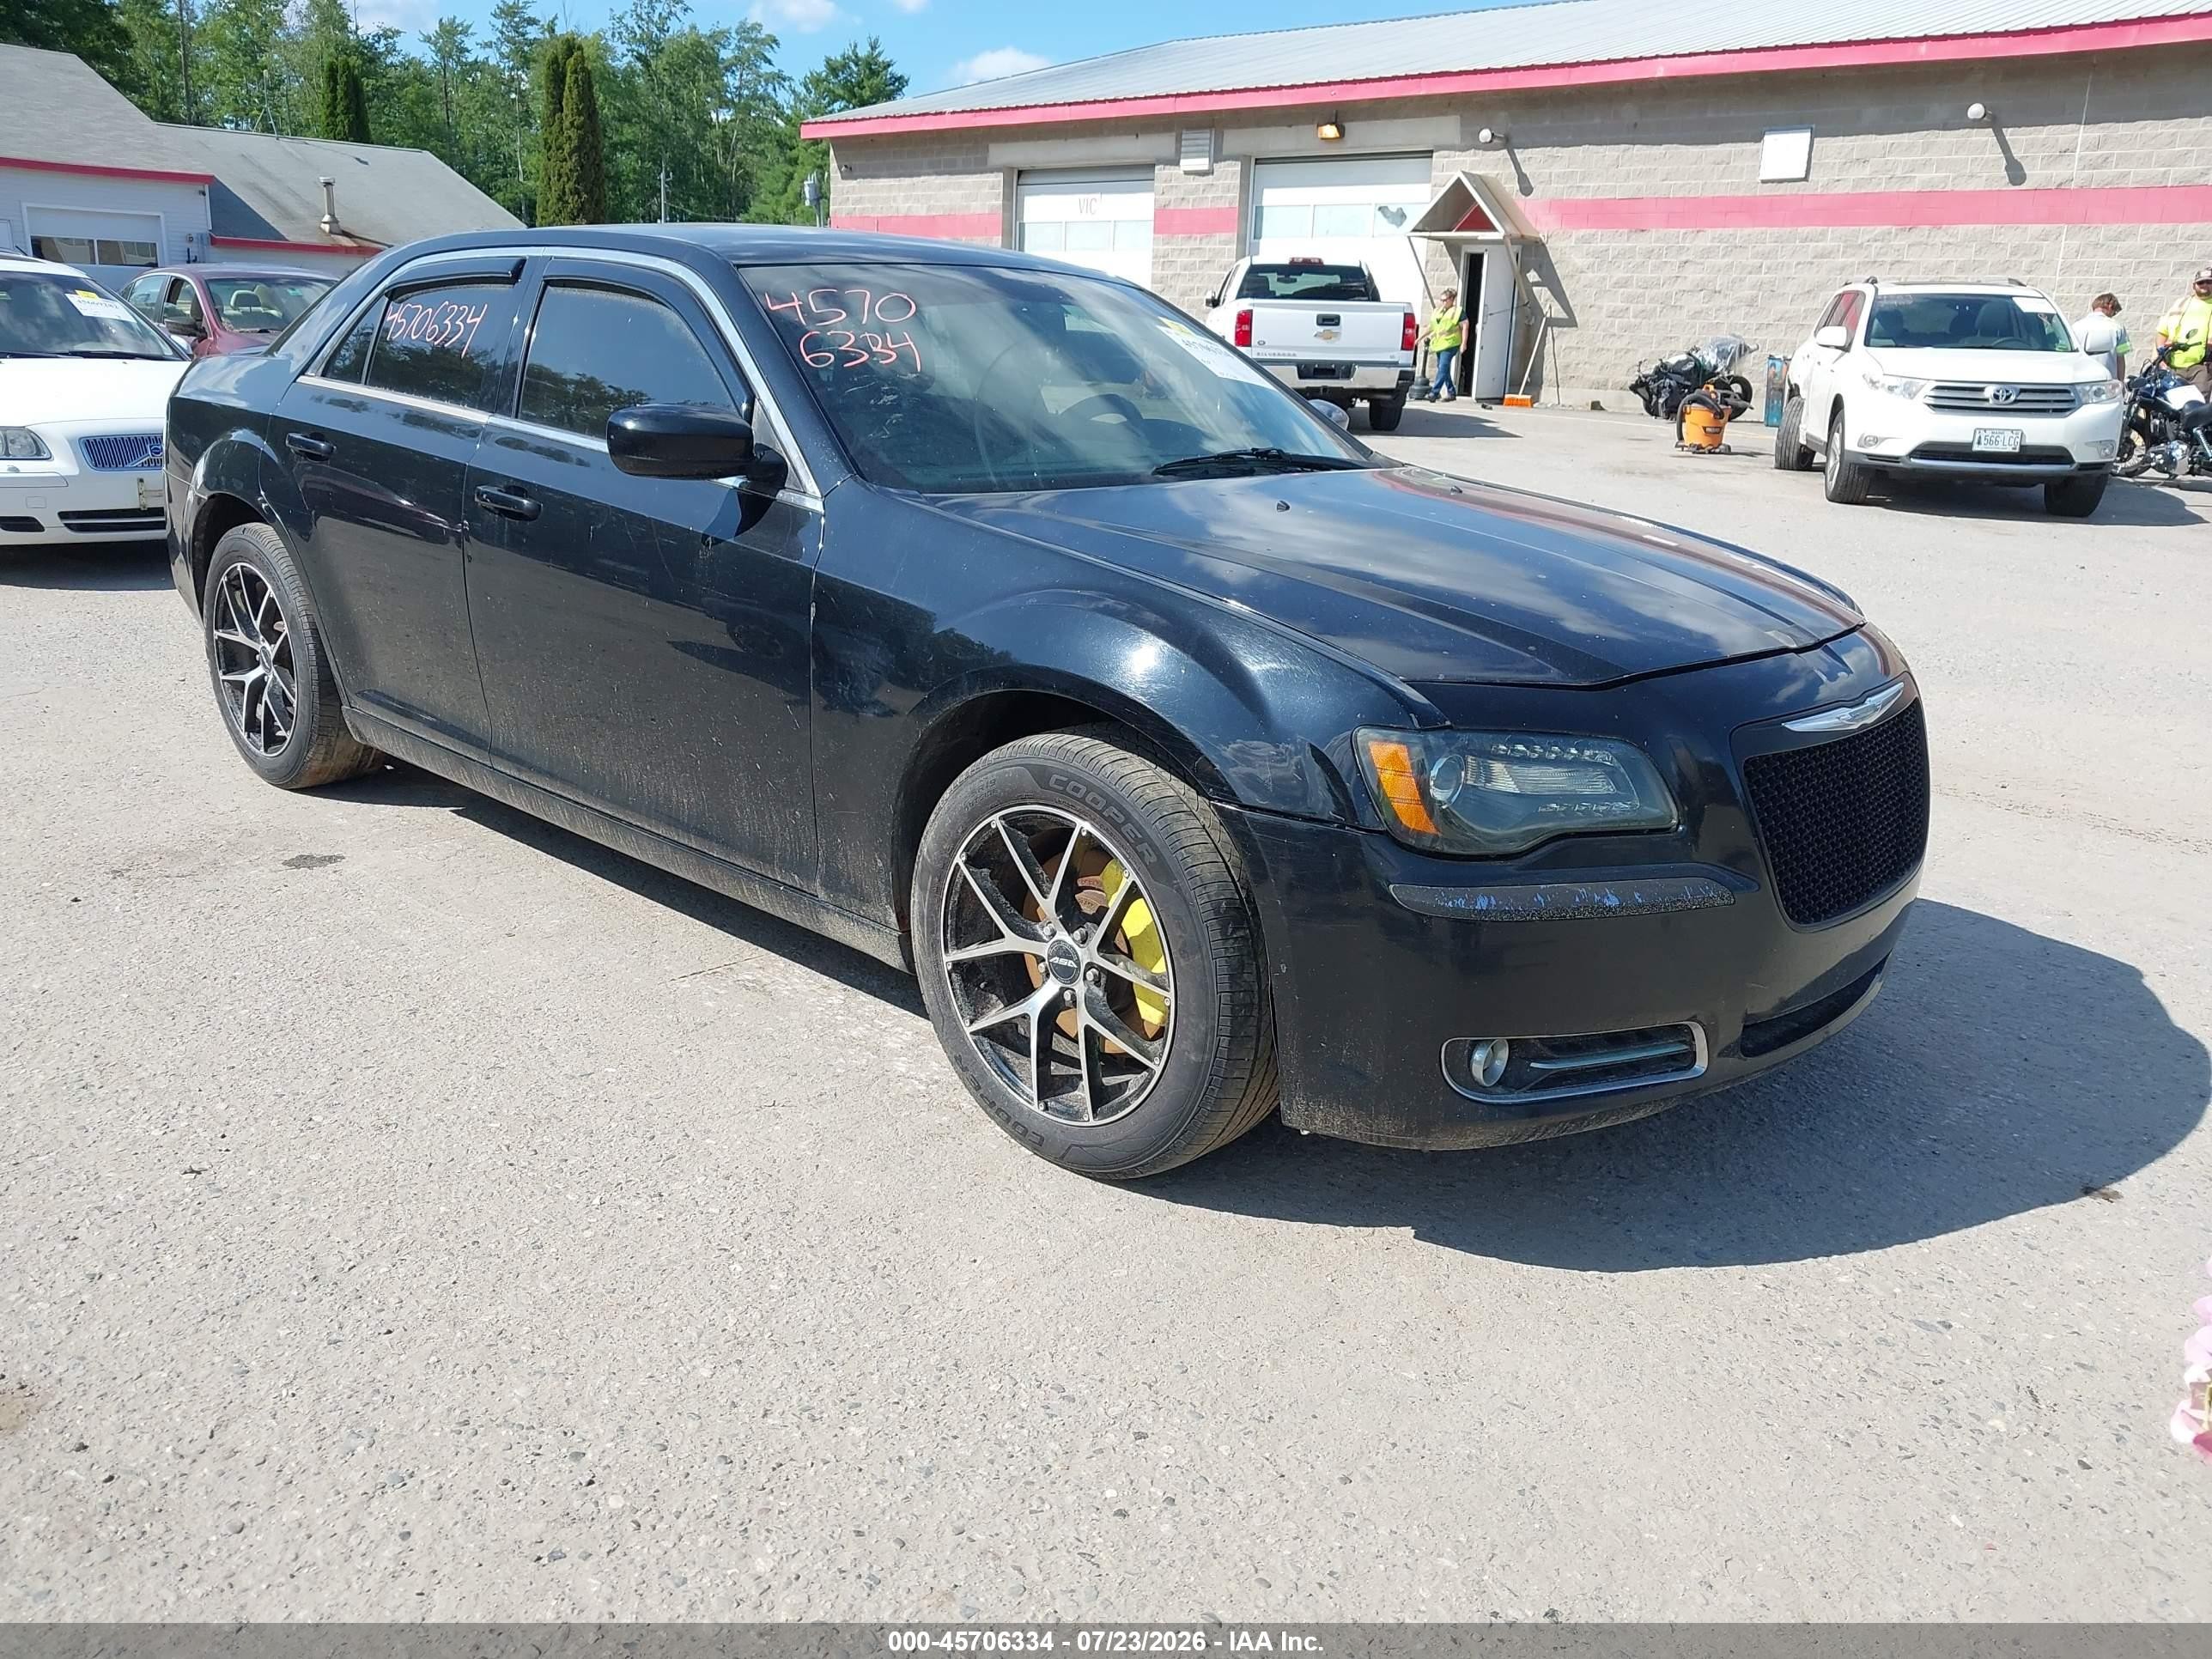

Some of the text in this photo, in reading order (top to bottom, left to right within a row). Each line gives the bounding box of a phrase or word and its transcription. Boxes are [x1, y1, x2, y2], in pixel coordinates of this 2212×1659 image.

[386, 301, 488, 360] 45706334
[764, 289, 916, 325] 4570
[1048, 774, 1157, 866] COOPER
[1049, 956, 1078, 969] ASA
